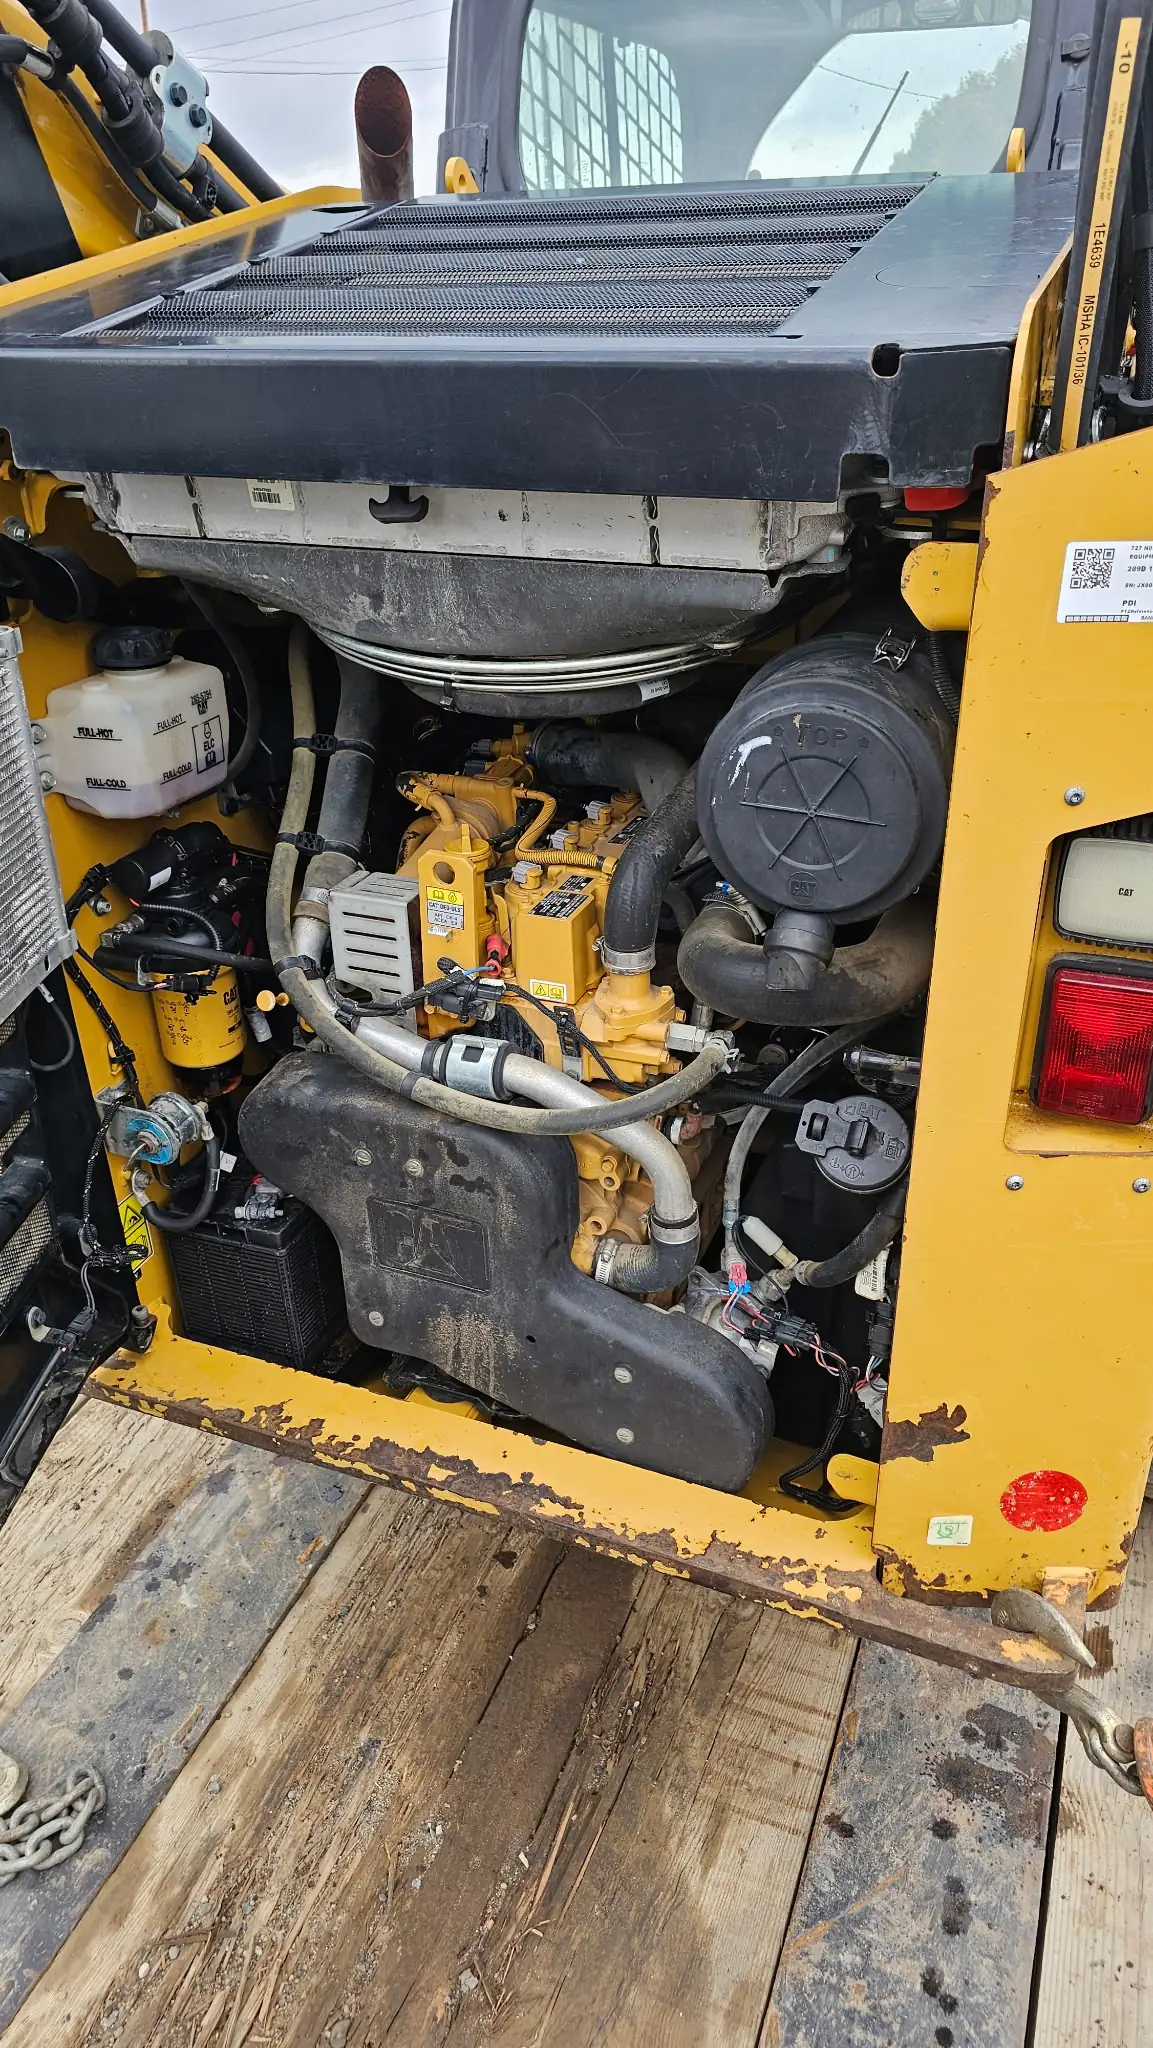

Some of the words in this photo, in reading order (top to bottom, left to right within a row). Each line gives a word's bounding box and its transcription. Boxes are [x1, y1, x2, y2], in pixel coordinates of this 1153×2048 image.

[1089, 223, 1106, 268] 1E4639
[1080, 295, 1095, 331] MSHA
[1072, 334, 1090, 385] IC-101/36
[157, 713, 183, 731] FULL-HOT
[77, 727, 114, 738] FULL-HOT
[799, 723, 848, 747] TOP
[203, 738, 215, 751] ELC
[163, 762, 192, 780] FULL-COLD
[86, 777, 127, 788] FULL-COLD
[790, 879, 817, 897] CAT
[1118, 887, 1134, 897] CAT
[223, 984, 238, 1006] CAT
